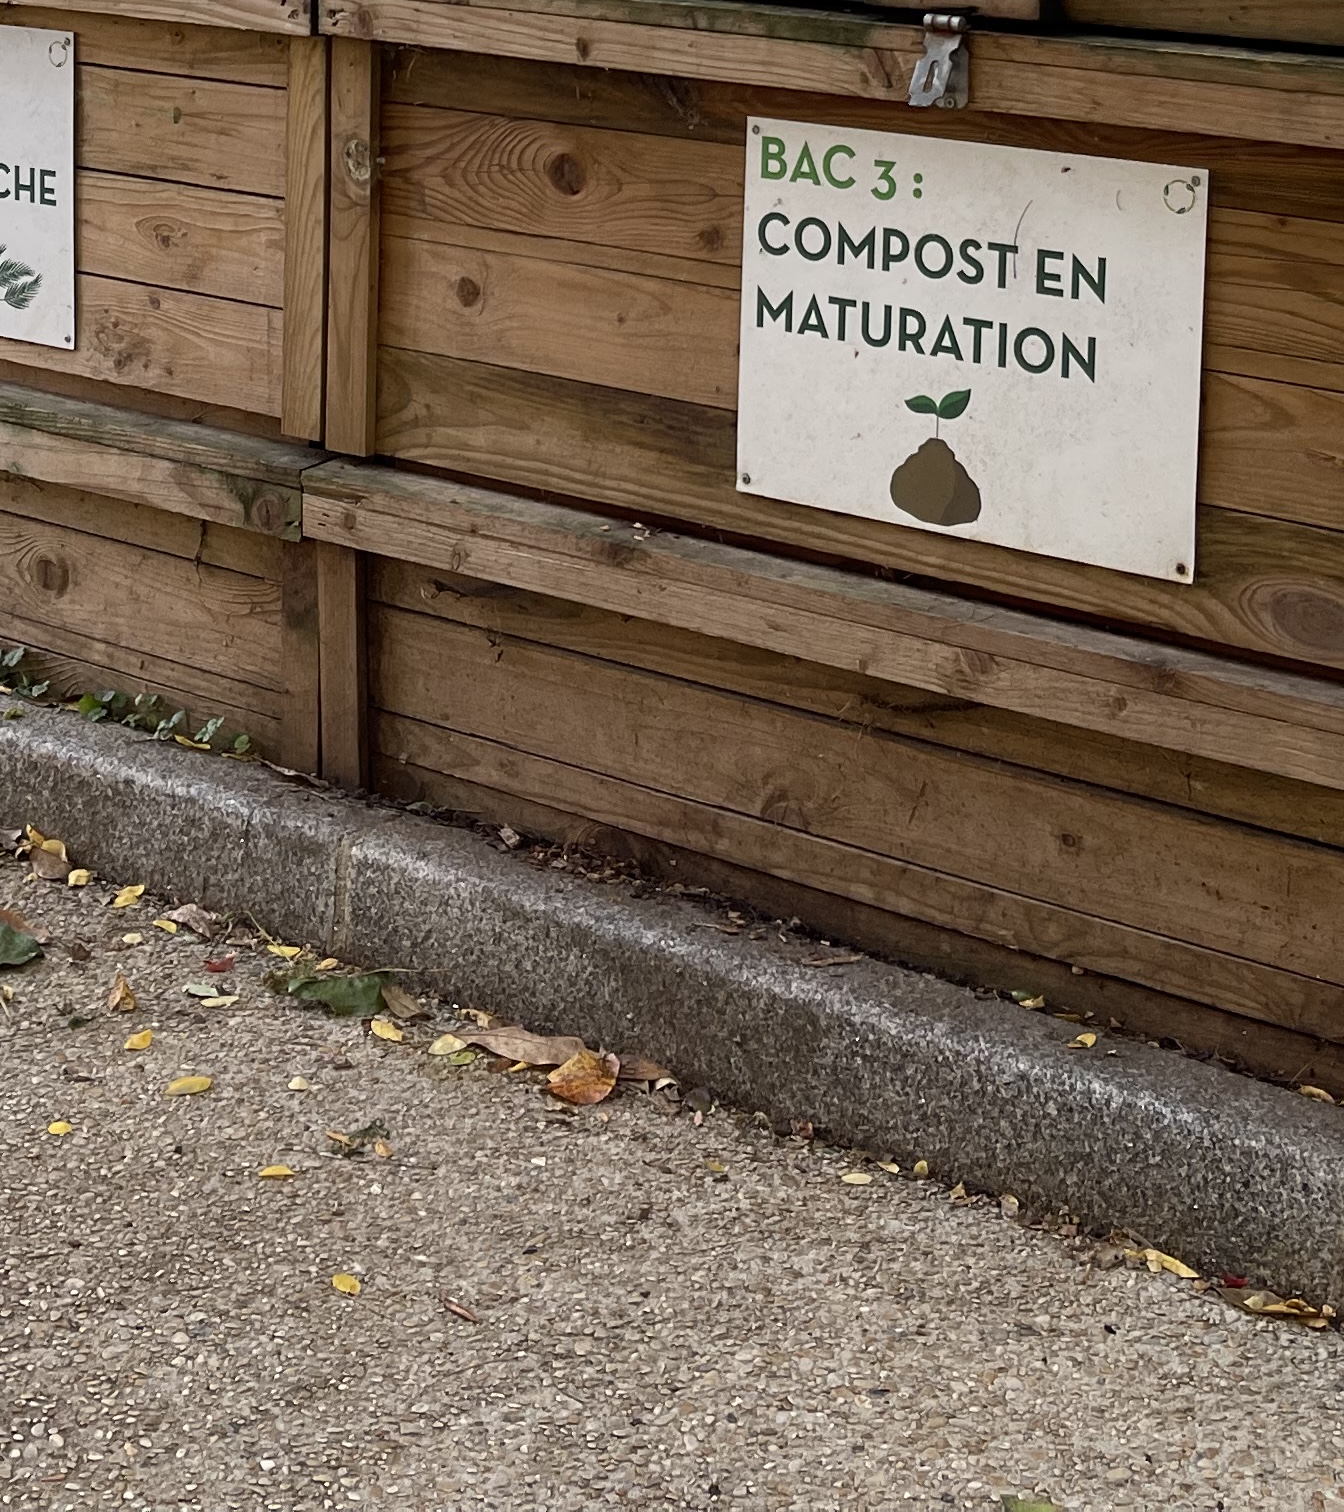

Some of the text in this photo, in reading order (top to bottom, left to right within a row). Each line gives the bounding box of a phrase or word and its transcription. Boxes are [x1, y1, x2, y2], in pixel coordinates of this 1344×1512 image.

[759, 134, 857, 190] BAC
[869, 158, 897, 201] 3
[756, 210, 1107, 304] COMPOST EN
[755, 283, 1097, 384] MATURATION
